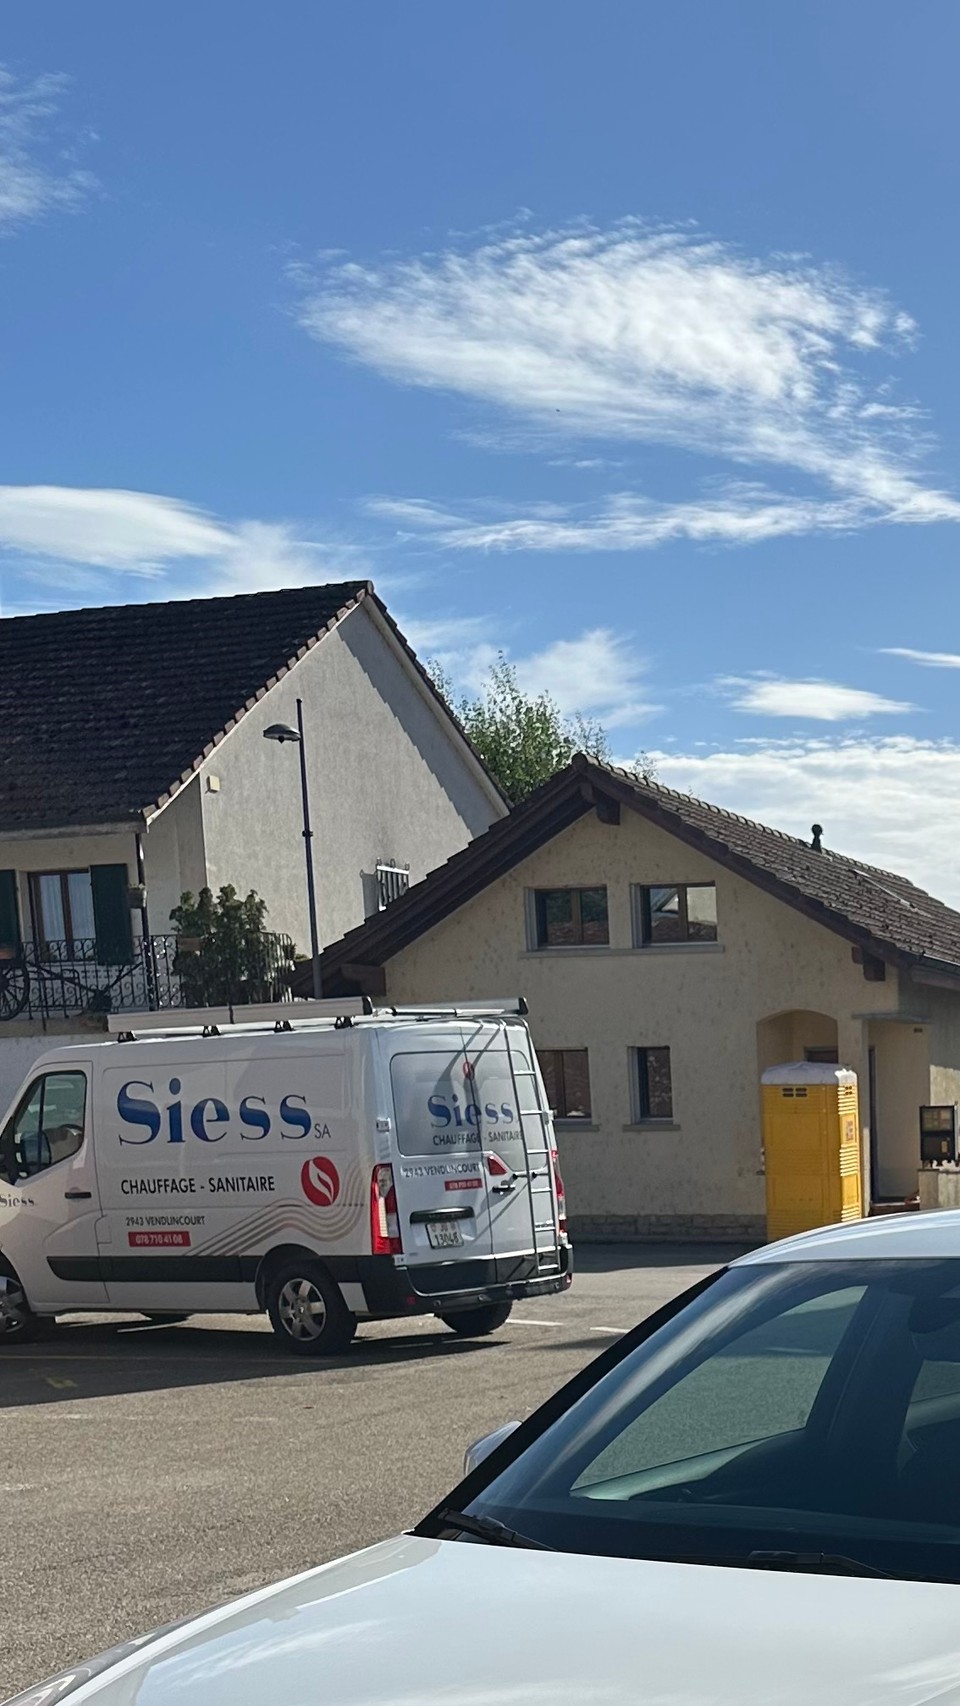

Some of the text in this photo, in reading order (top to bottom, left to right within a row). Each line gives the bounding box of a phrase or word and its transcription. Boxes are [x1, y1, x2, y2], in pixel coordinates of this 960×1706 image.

[117, 1078, 331, 1145] Siess SA
[427, 1094, 513, 1128] Siess
[433, 1132, 481, 1146] CHAUFFAGE
[121, 1178, 196, 1194] CHAUFFAGE
[209, 1176, 275, 1192] SANITAIRE
[126, 1215, 205, 1227] 2943 VENDLINCOURT
